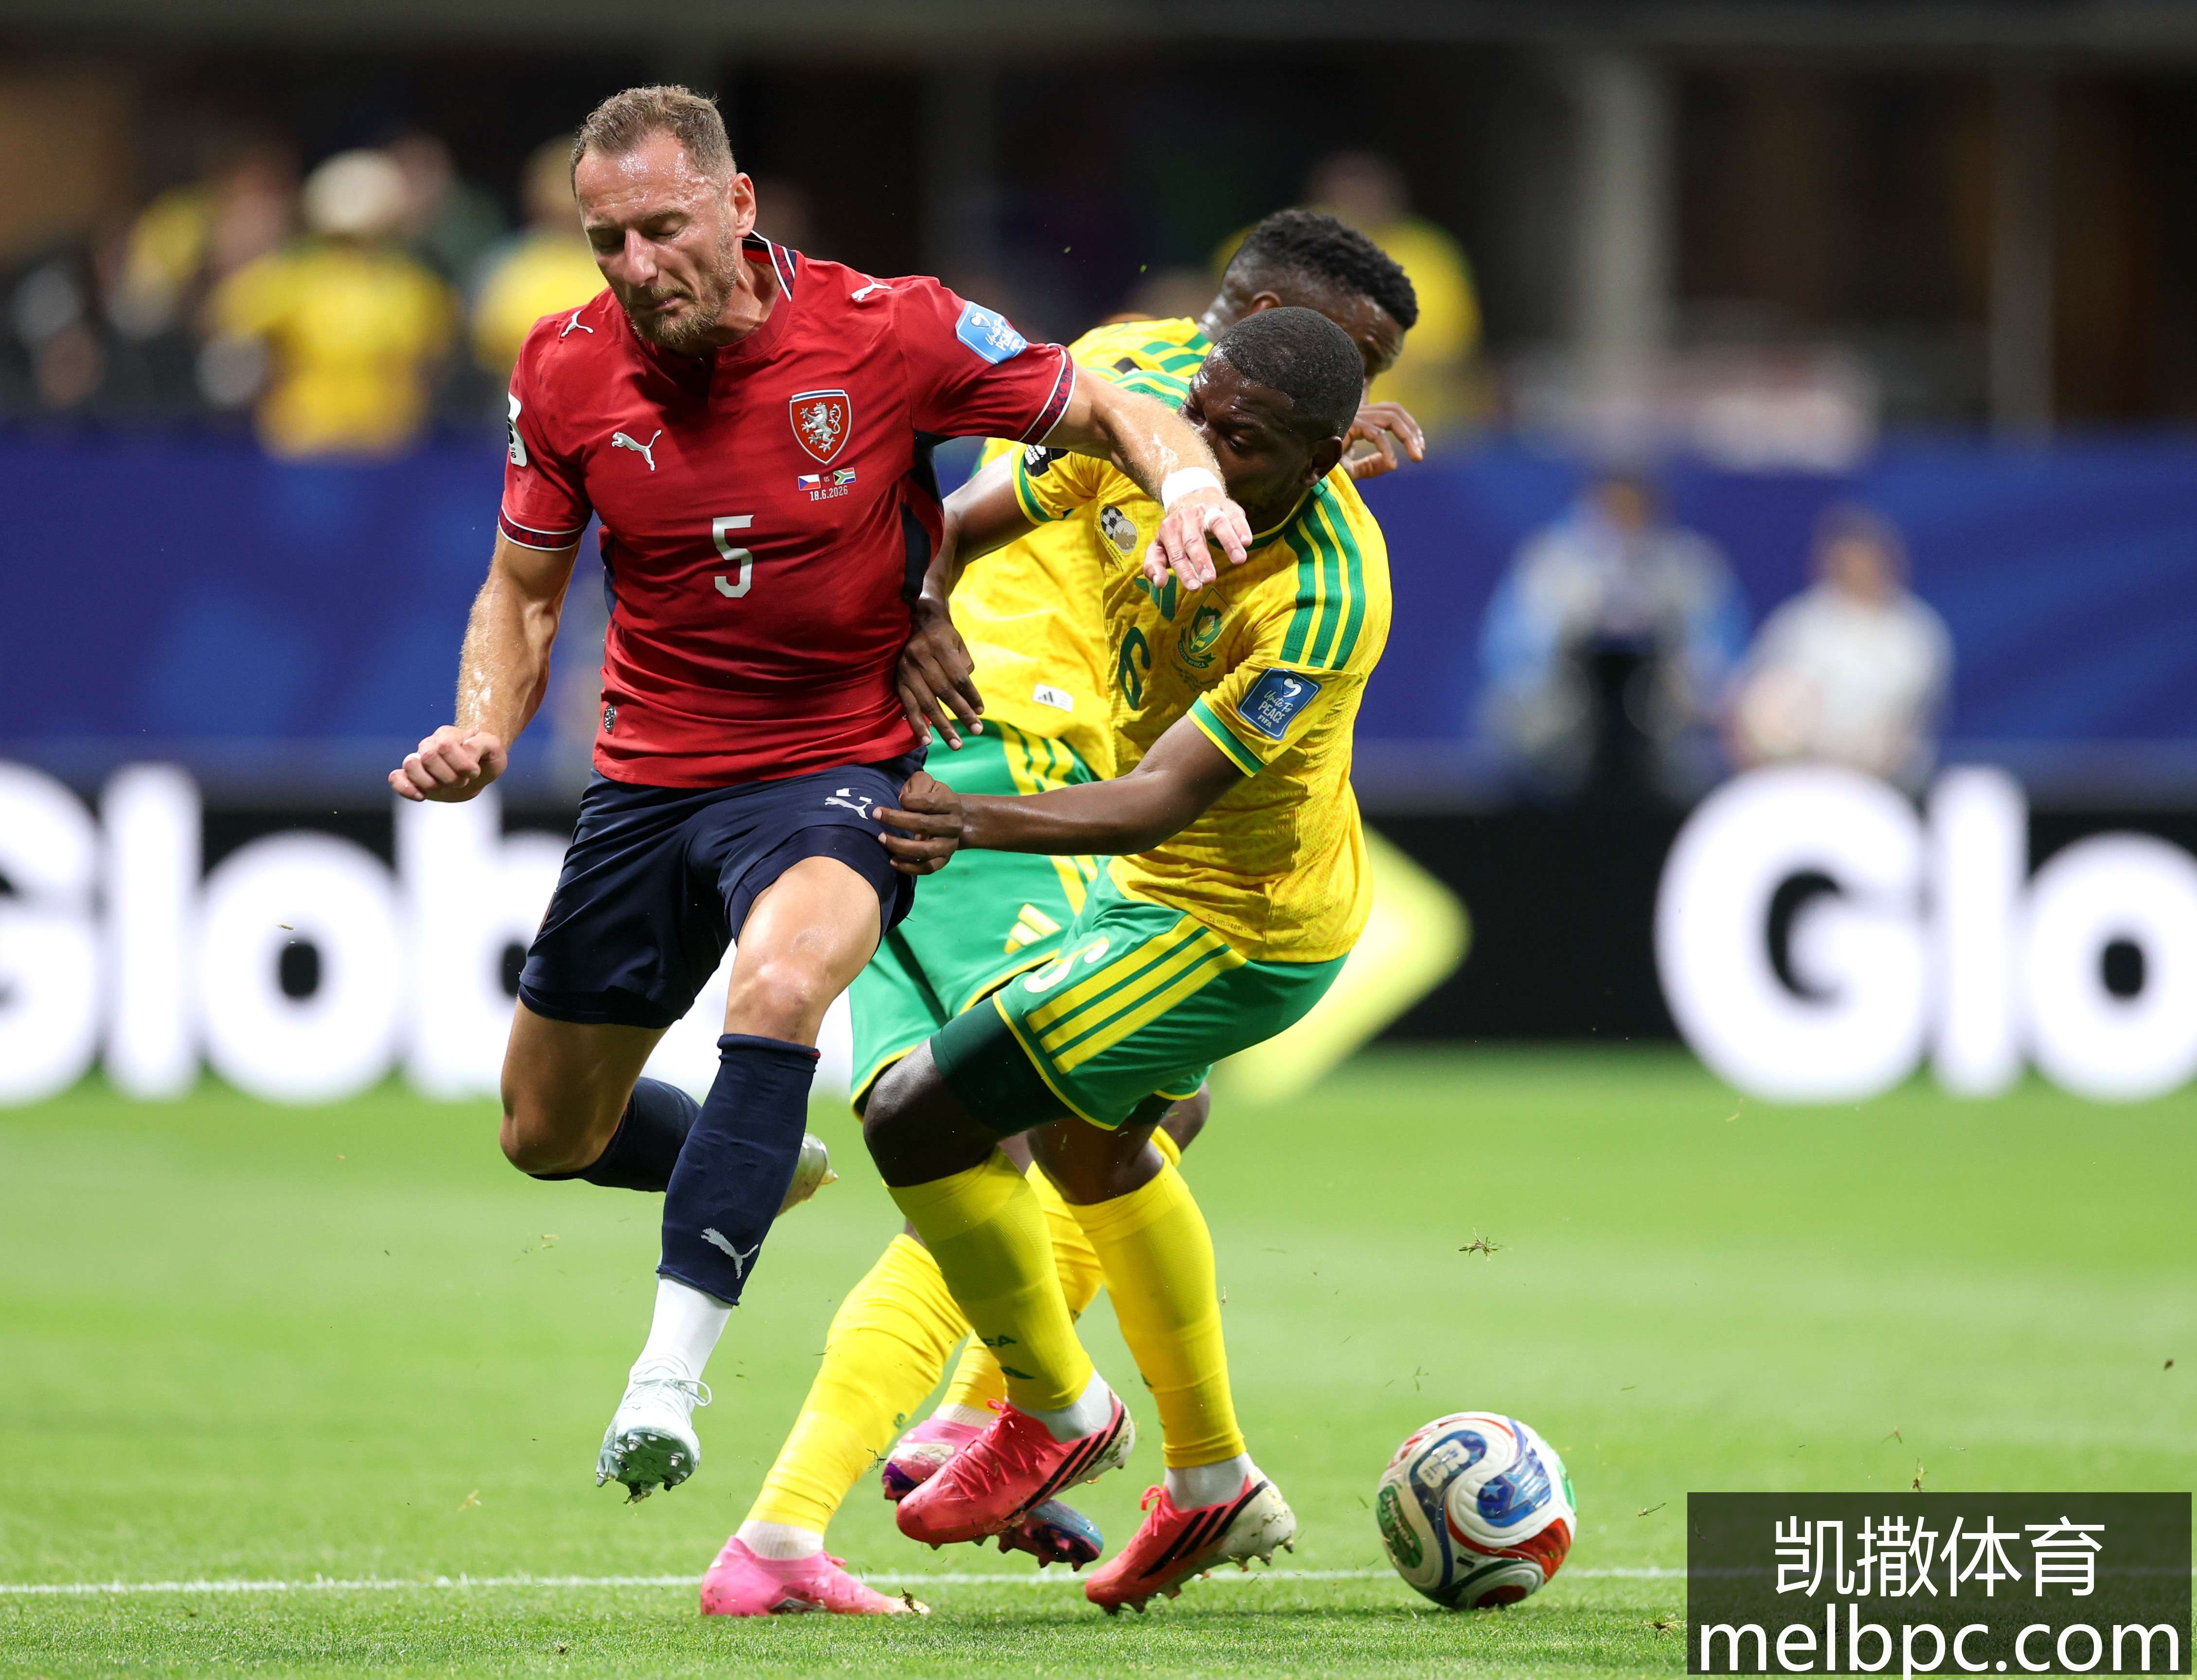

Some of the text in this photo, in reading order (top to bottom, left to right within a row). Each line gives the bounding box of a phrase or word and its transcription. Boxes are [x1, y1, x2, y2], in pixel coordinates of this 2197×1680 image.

[809, 485, 849, 501] 18.6.2026
[713, 515, 754, 598] 5
[1119, 626, 1151, 711] 6
[1264, 690, 1285, 708] Unite
[1257, 715, 1272, 728] FIFA
[1258, 700, 1286, 724] PEACE
